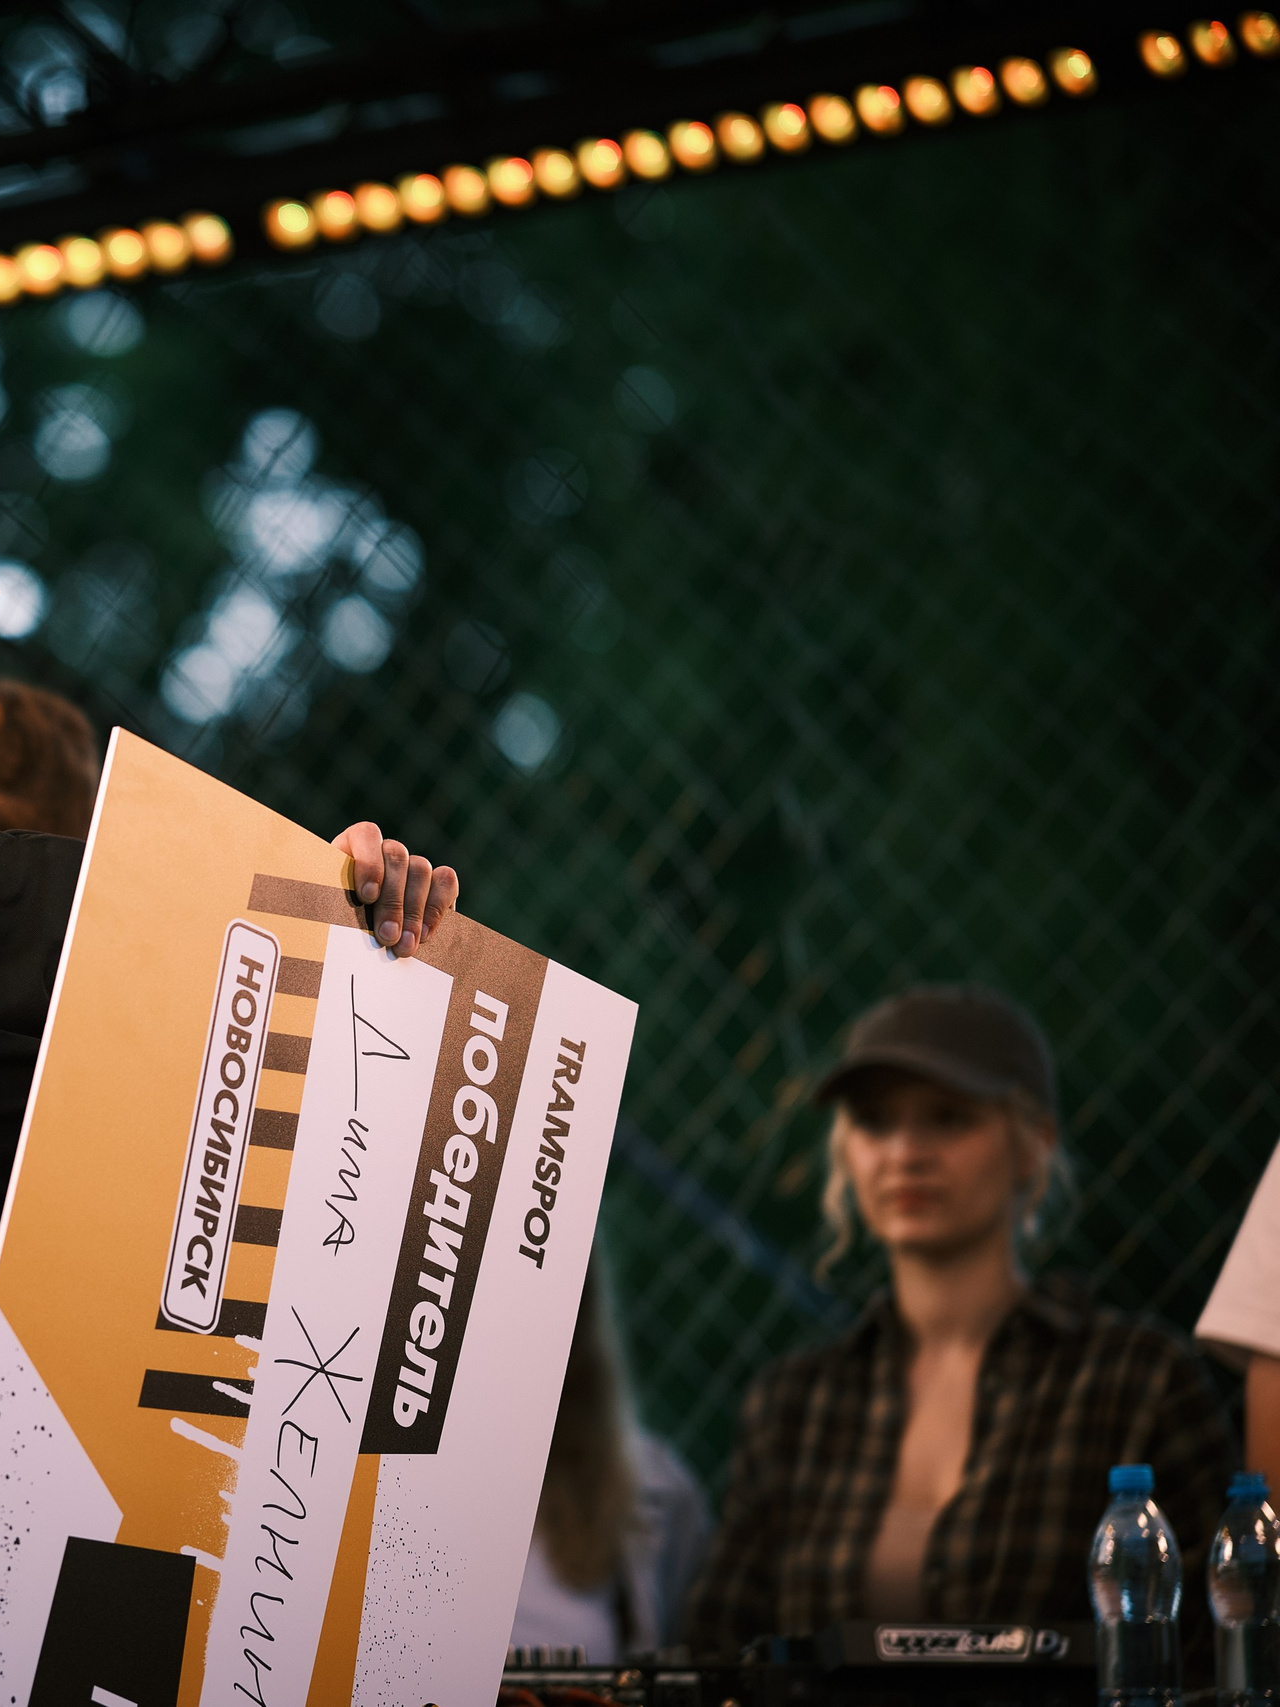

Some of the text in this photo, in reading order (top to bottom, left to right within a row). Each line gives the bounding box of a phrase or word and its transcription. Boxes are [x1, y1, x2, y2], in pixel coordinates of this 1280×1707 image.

[181, 955, 264, 1300] НОВОСИБИРСК
[393, 990, 509, 1428] победитель
[519, 1038, 586, 1269] TRAMSPOT
